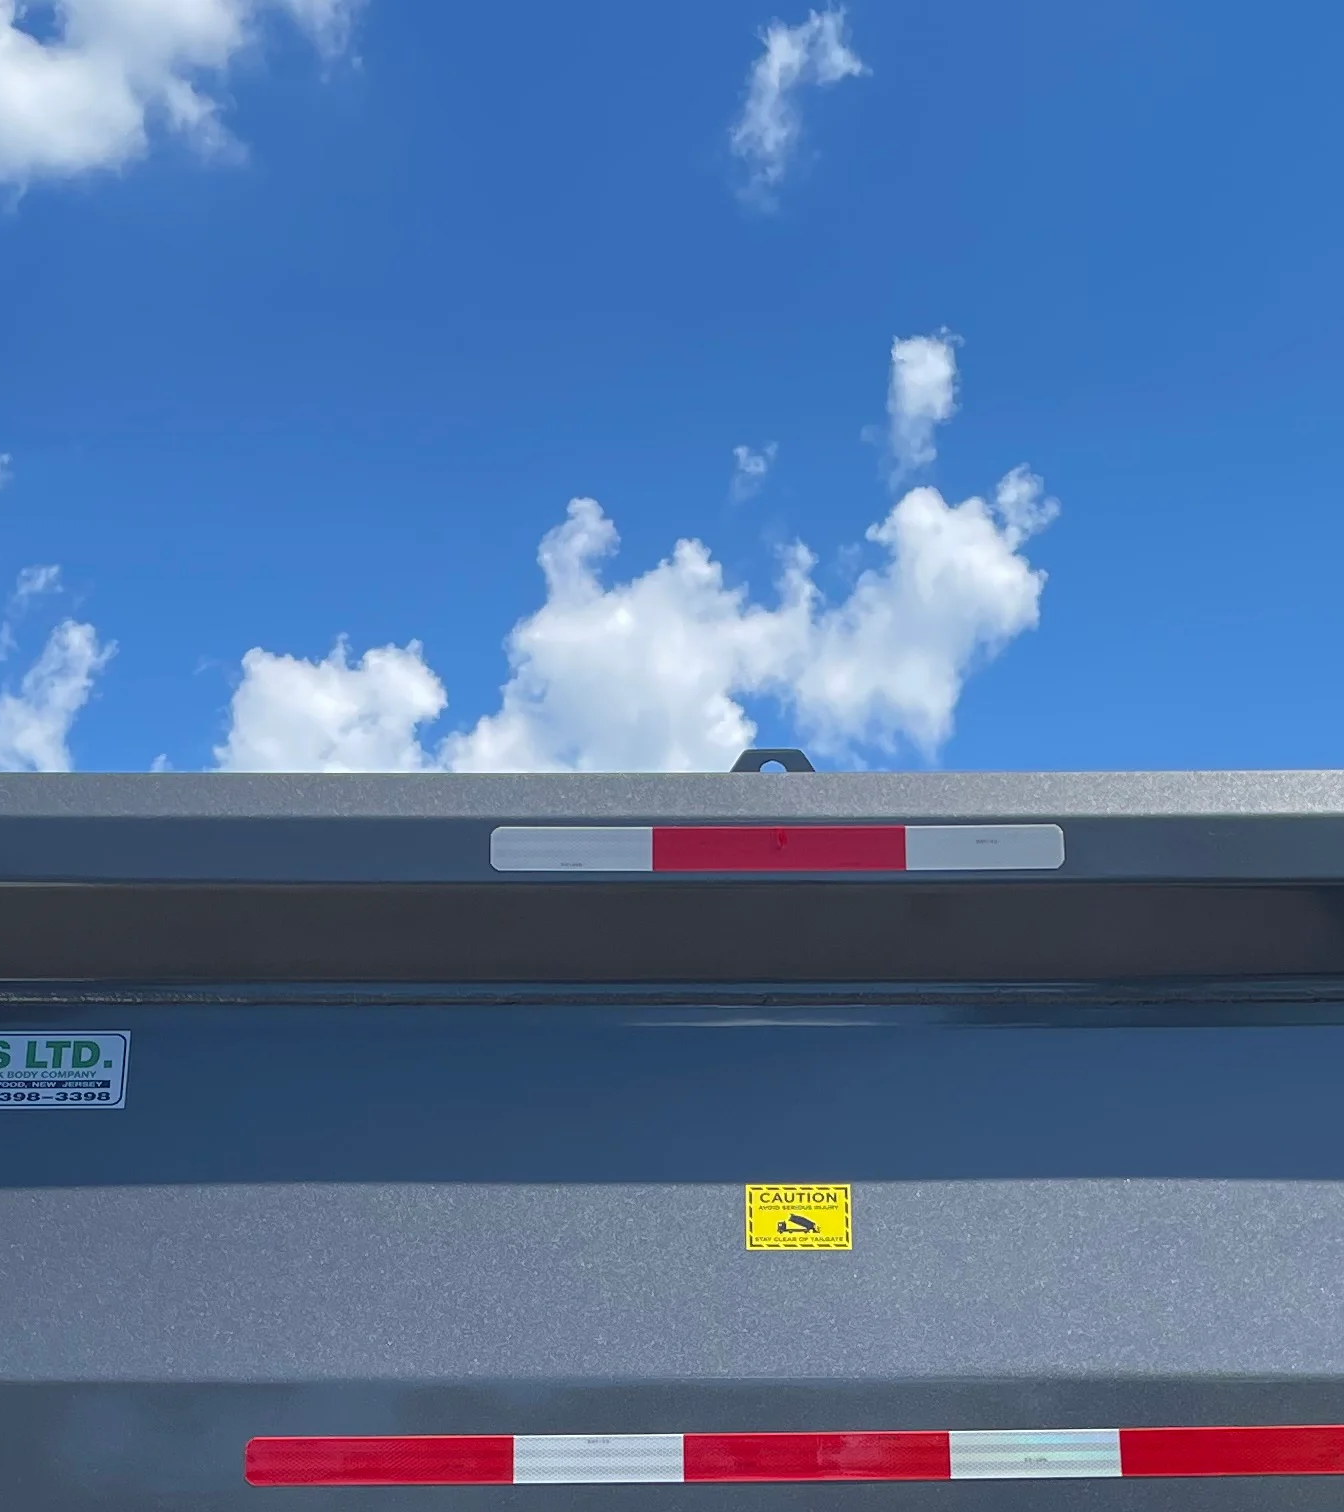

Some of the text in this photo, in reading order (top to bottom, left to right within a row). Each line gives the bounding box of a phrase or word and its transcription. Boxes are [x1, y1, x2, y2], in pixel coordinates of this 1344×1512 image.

[25, 1040, 113, 1069] LTD.
[7, 1070, 38, 1079] BODY
[41, 1070, 97, 1079] COMPANY
[0, 1091, 111, 1102] 398-3398
[759, 1192, 838, 1204] CAUTION
